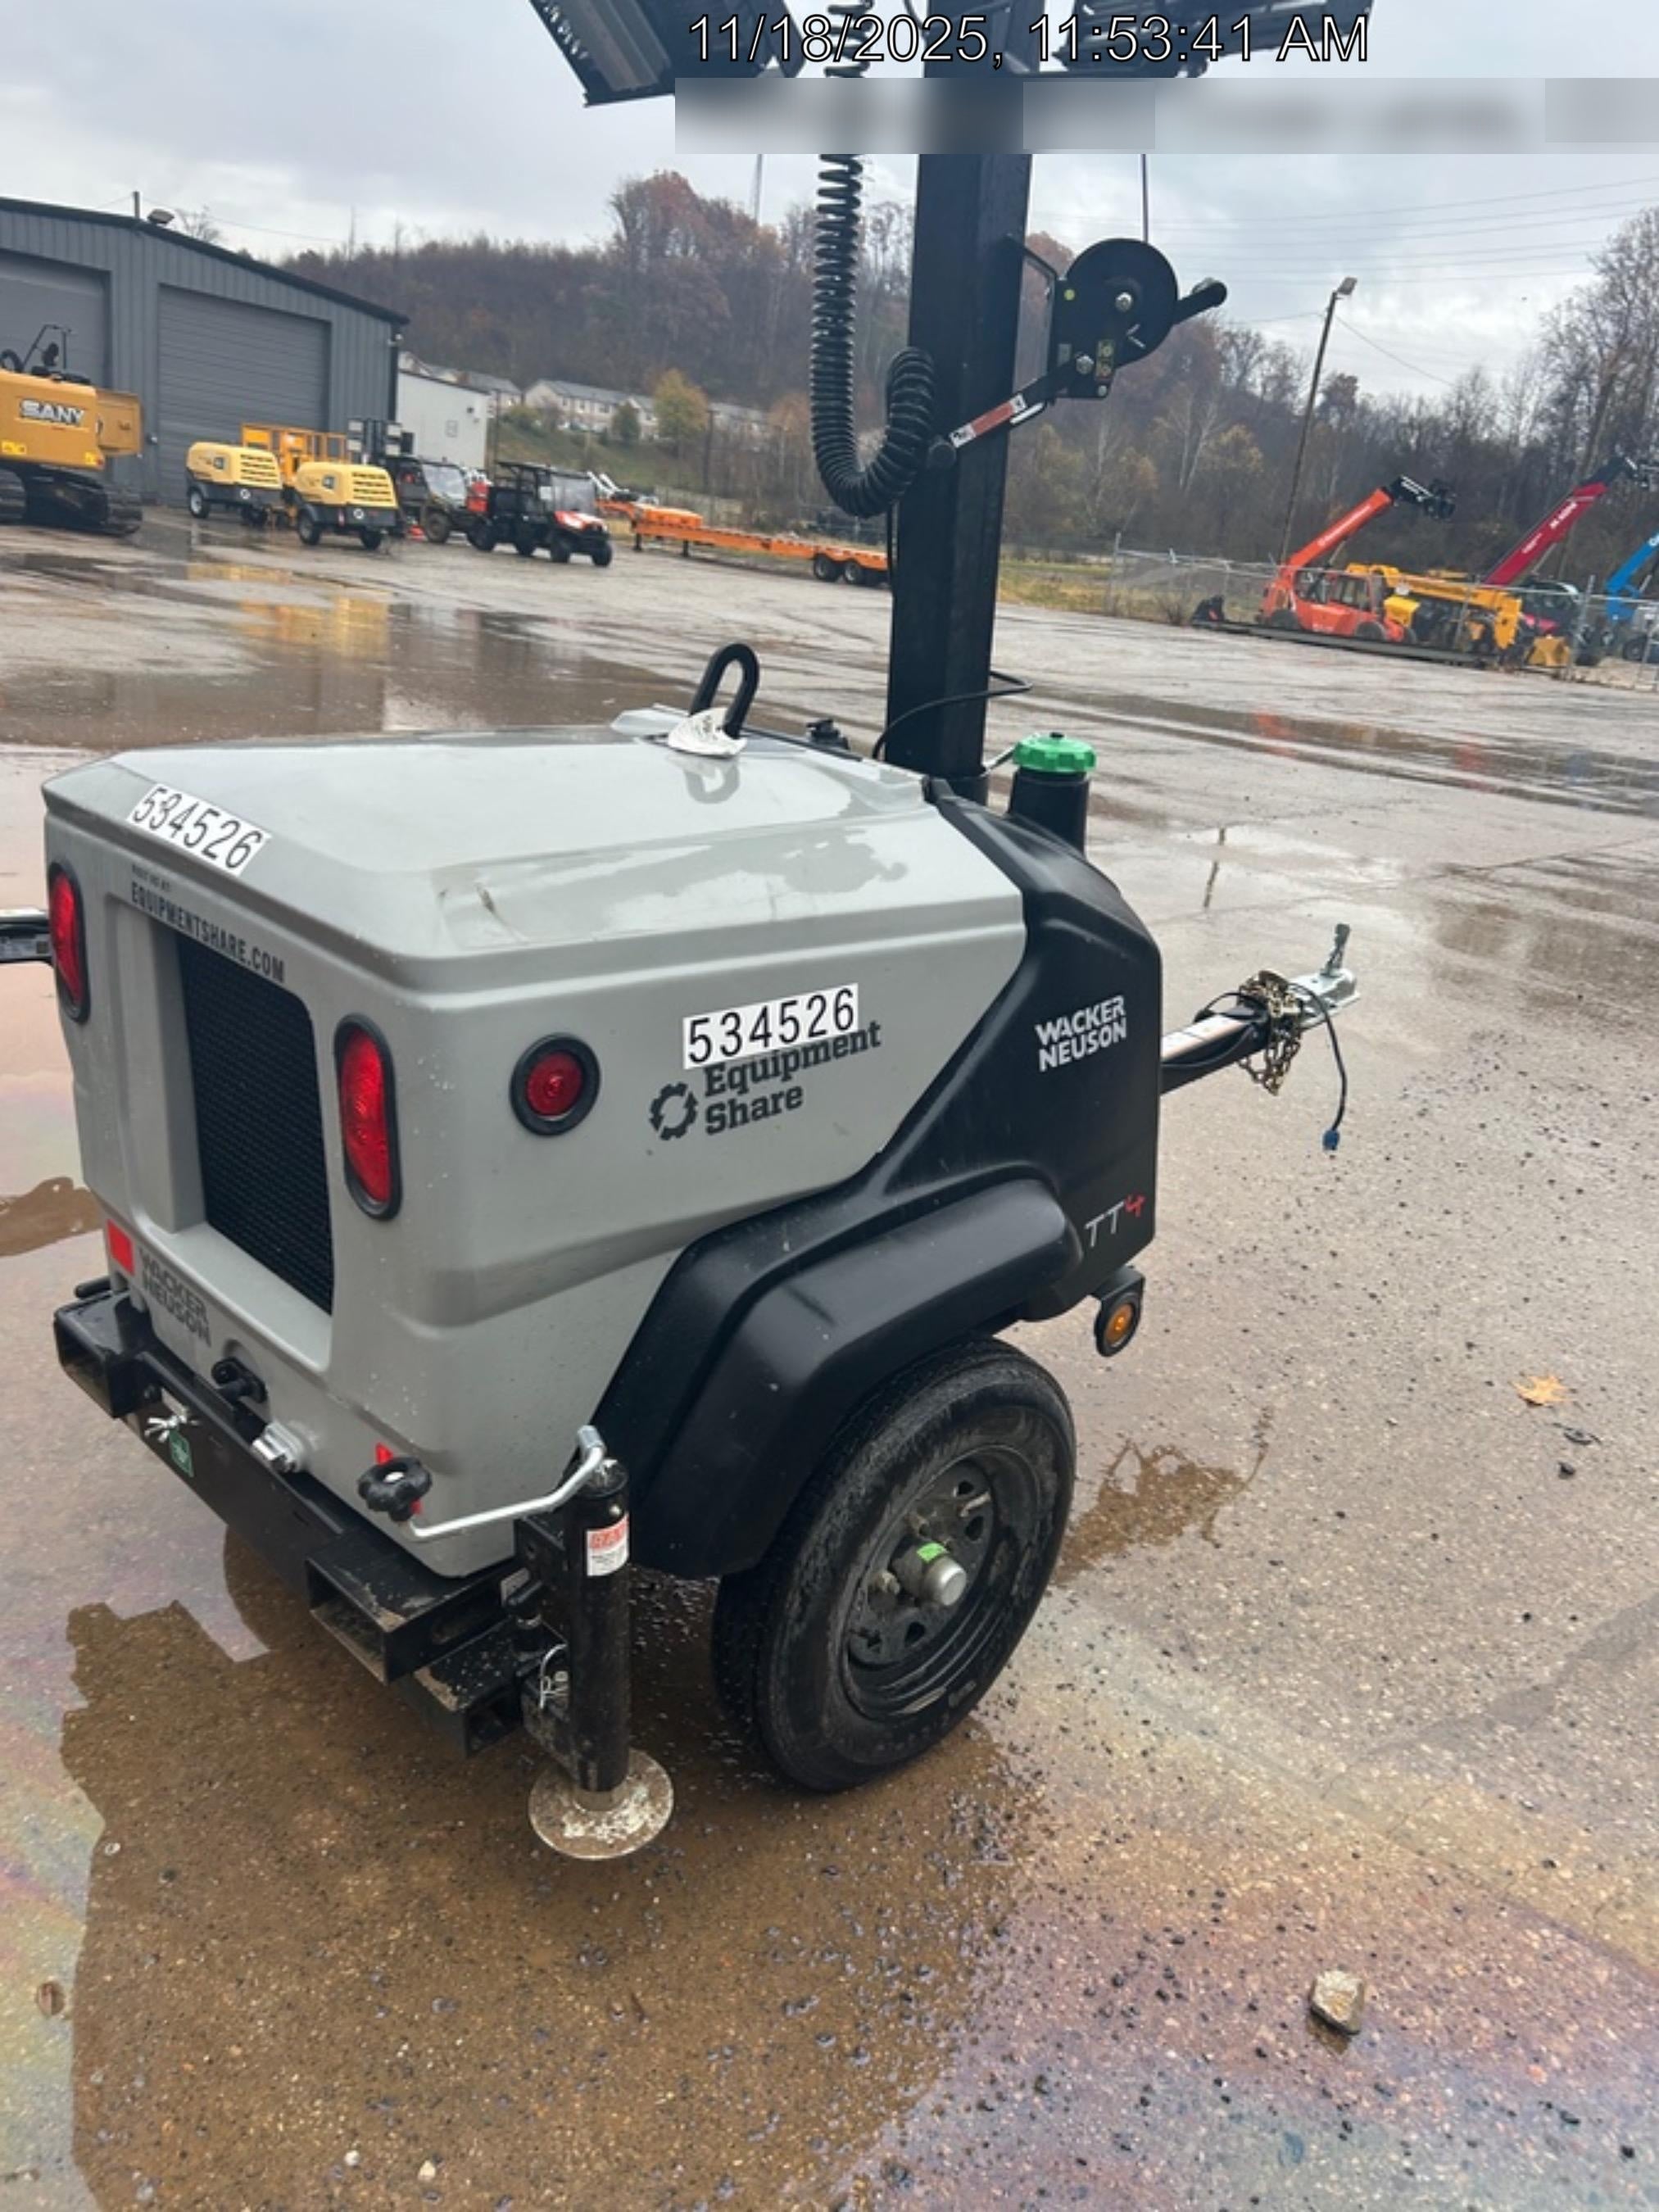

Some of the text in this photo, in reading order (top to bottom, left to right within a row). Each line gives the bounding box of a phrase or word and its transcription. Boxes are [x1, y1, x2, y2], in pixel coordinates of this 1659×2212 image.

[20, 398, 84, 426] SANY
[133, 787, 264, 868] 534526
[132, 882, 284, 983] EQUIPMENTSHARE.COM
[689, 988, 854, 1063] 534526
[1035, 995, 1126, 1046] WACKER
[1039, 1018, 1127, 1072] NEUSON
[704, 1020, 882, 1097] Equipment
[705, 1086, 804, 1135] Share
